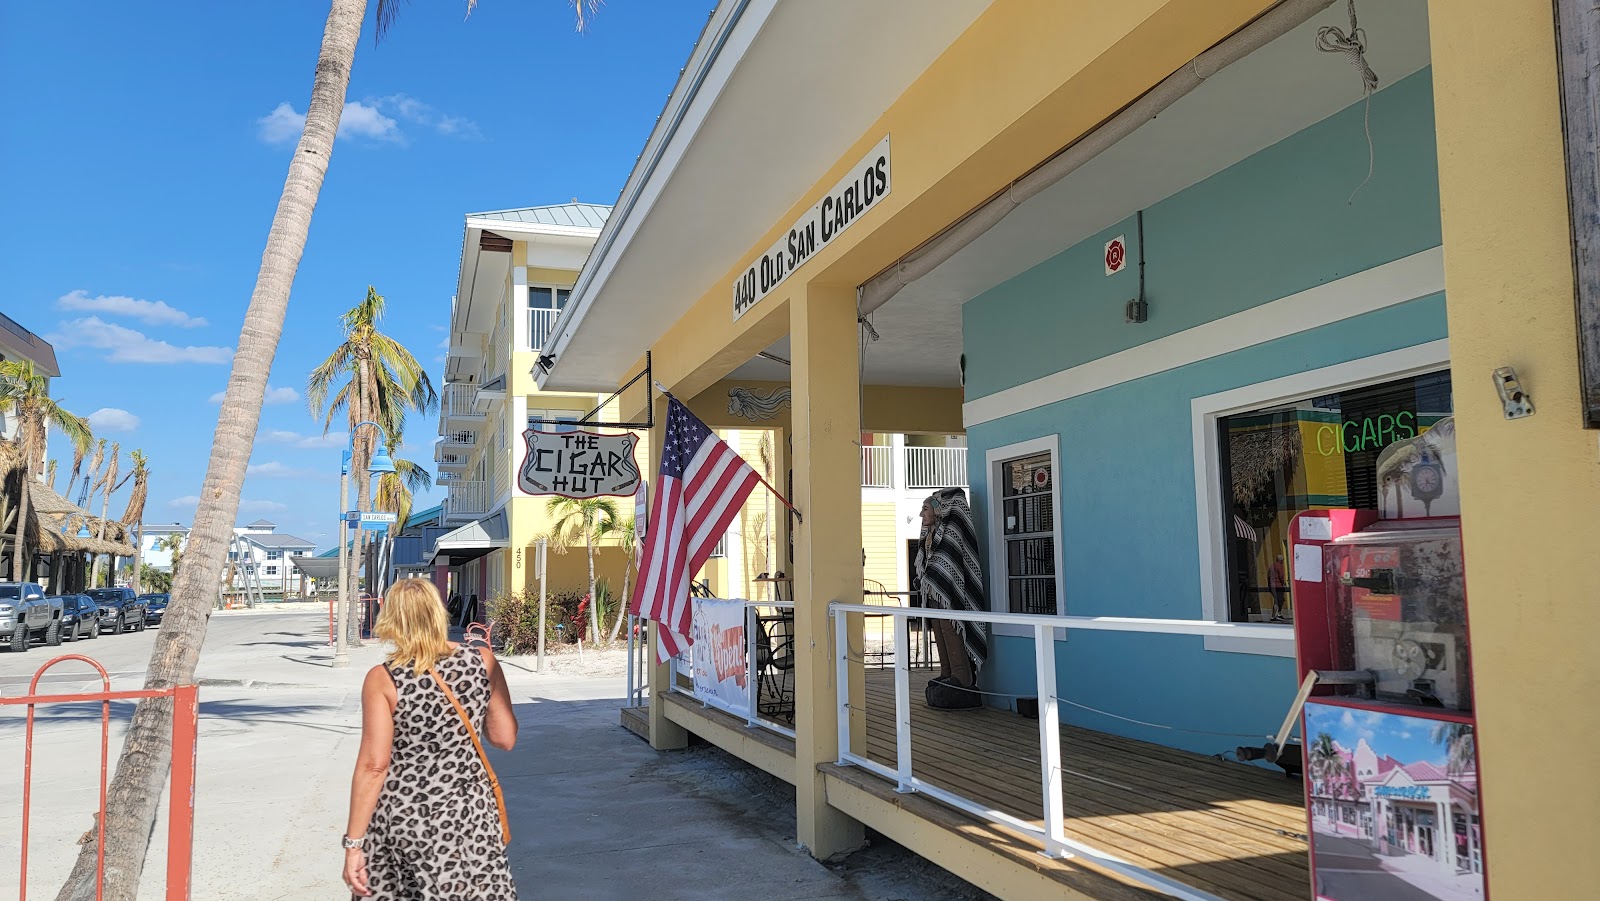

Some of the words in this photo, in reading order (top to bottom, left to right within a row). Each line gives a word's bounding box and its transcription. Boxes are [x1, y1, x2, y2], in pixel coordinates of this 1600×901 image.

[735, 267, 756, 314] 440
[760, 251, 784, 294] OLD
[788, 220, 815, 271] SAN
[821, 155, 886, 243] CARLOS
[560, 435, 600, 450] THE
[1317, 411, 1415, 456] CIGARS
[535, 448, 623, 478] CIGAR
[552, 475, 605, 493] HUT
